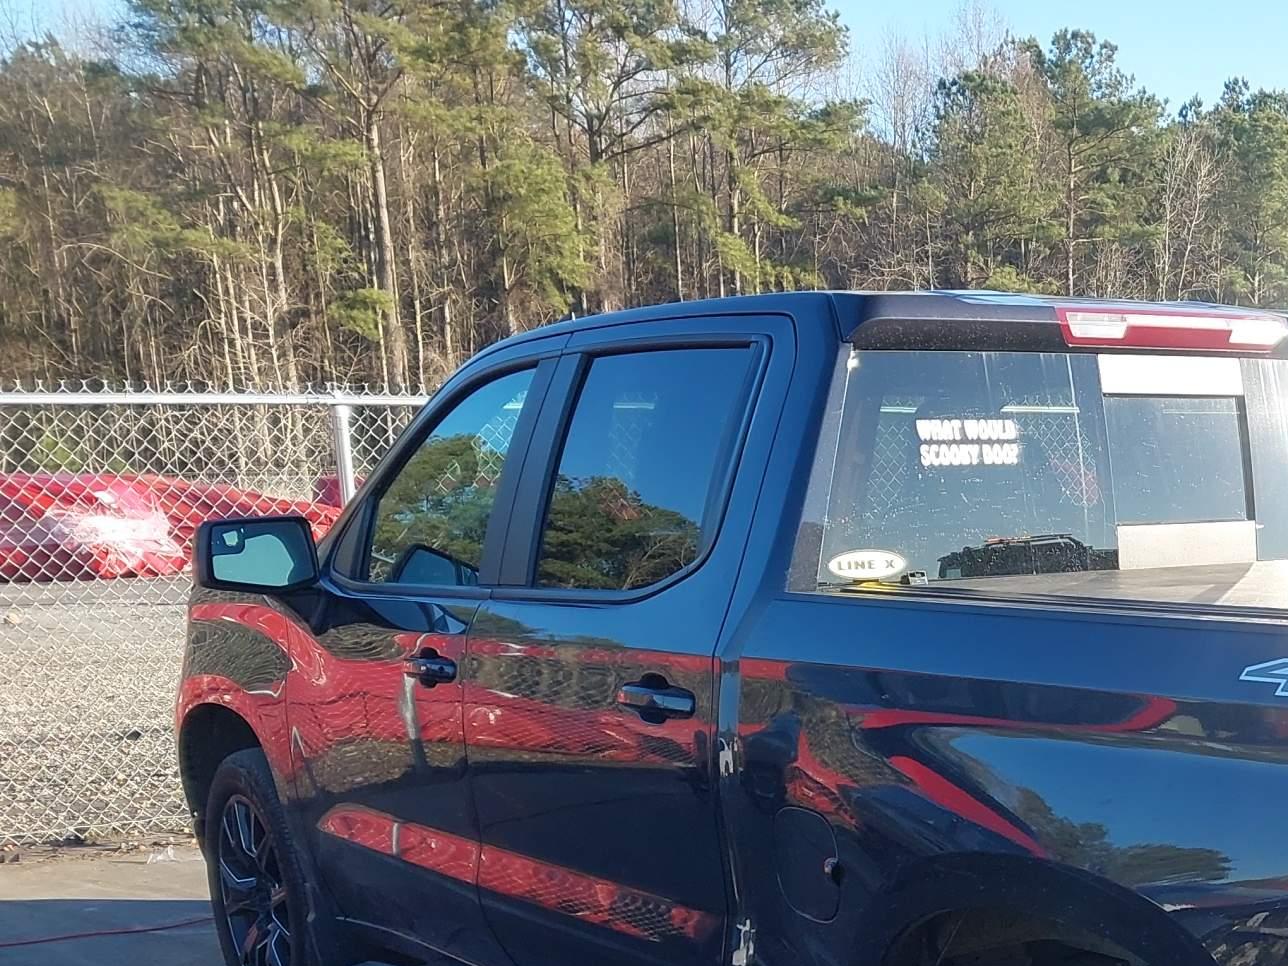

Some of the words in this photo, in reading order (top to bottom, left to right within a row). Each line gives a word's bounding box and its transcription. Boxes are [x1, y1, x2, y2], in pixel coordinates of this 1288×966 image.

[916, 419, 962, 440] WHAT
[964, 419, 1017, 440] WOULD
[837, 560, 877, 571] LINE
[885, 559, 896, 569] X
